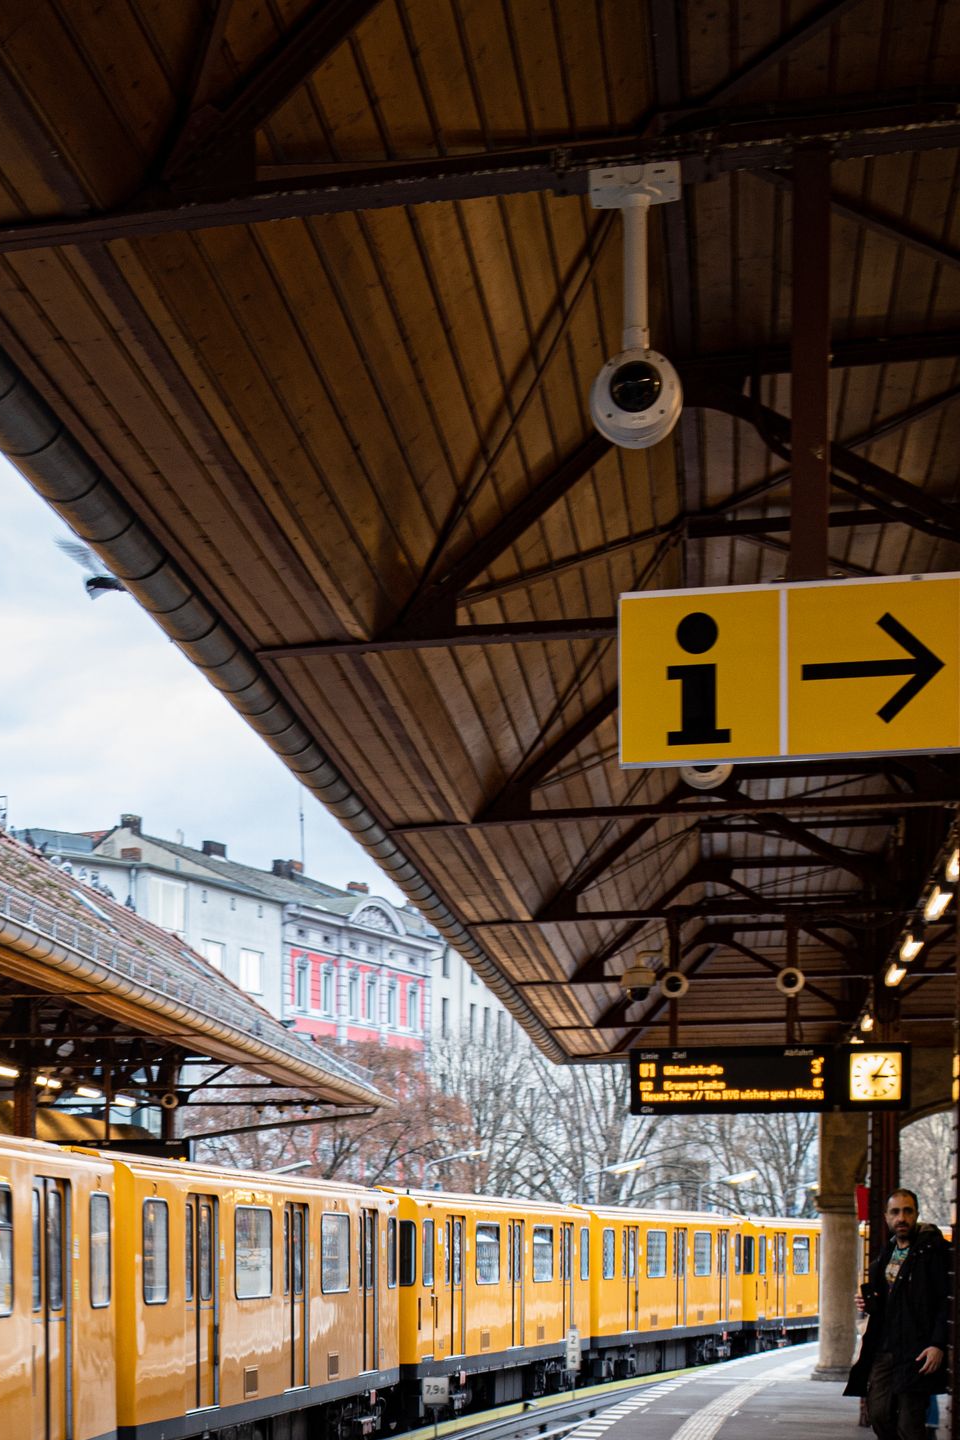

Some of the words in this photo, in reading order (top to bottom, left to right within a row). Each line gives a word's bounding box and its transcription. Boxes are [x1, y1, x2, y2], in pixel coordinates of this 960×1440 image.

[640, 1052, 659, 1060] Linie
[672, 1051, 687, 1059] Ziel
[639, 1063, 656, 1078] U1
[641, 1091, 669, 1102] Neues
[704, 1090, 722, 1100] The
[740, 1089, 770, 1100] wishes
[770, 1091, 788, 1101] you
[788, 1090, 796, 1099] a
[795, 1088, 825, 1100] Happy
